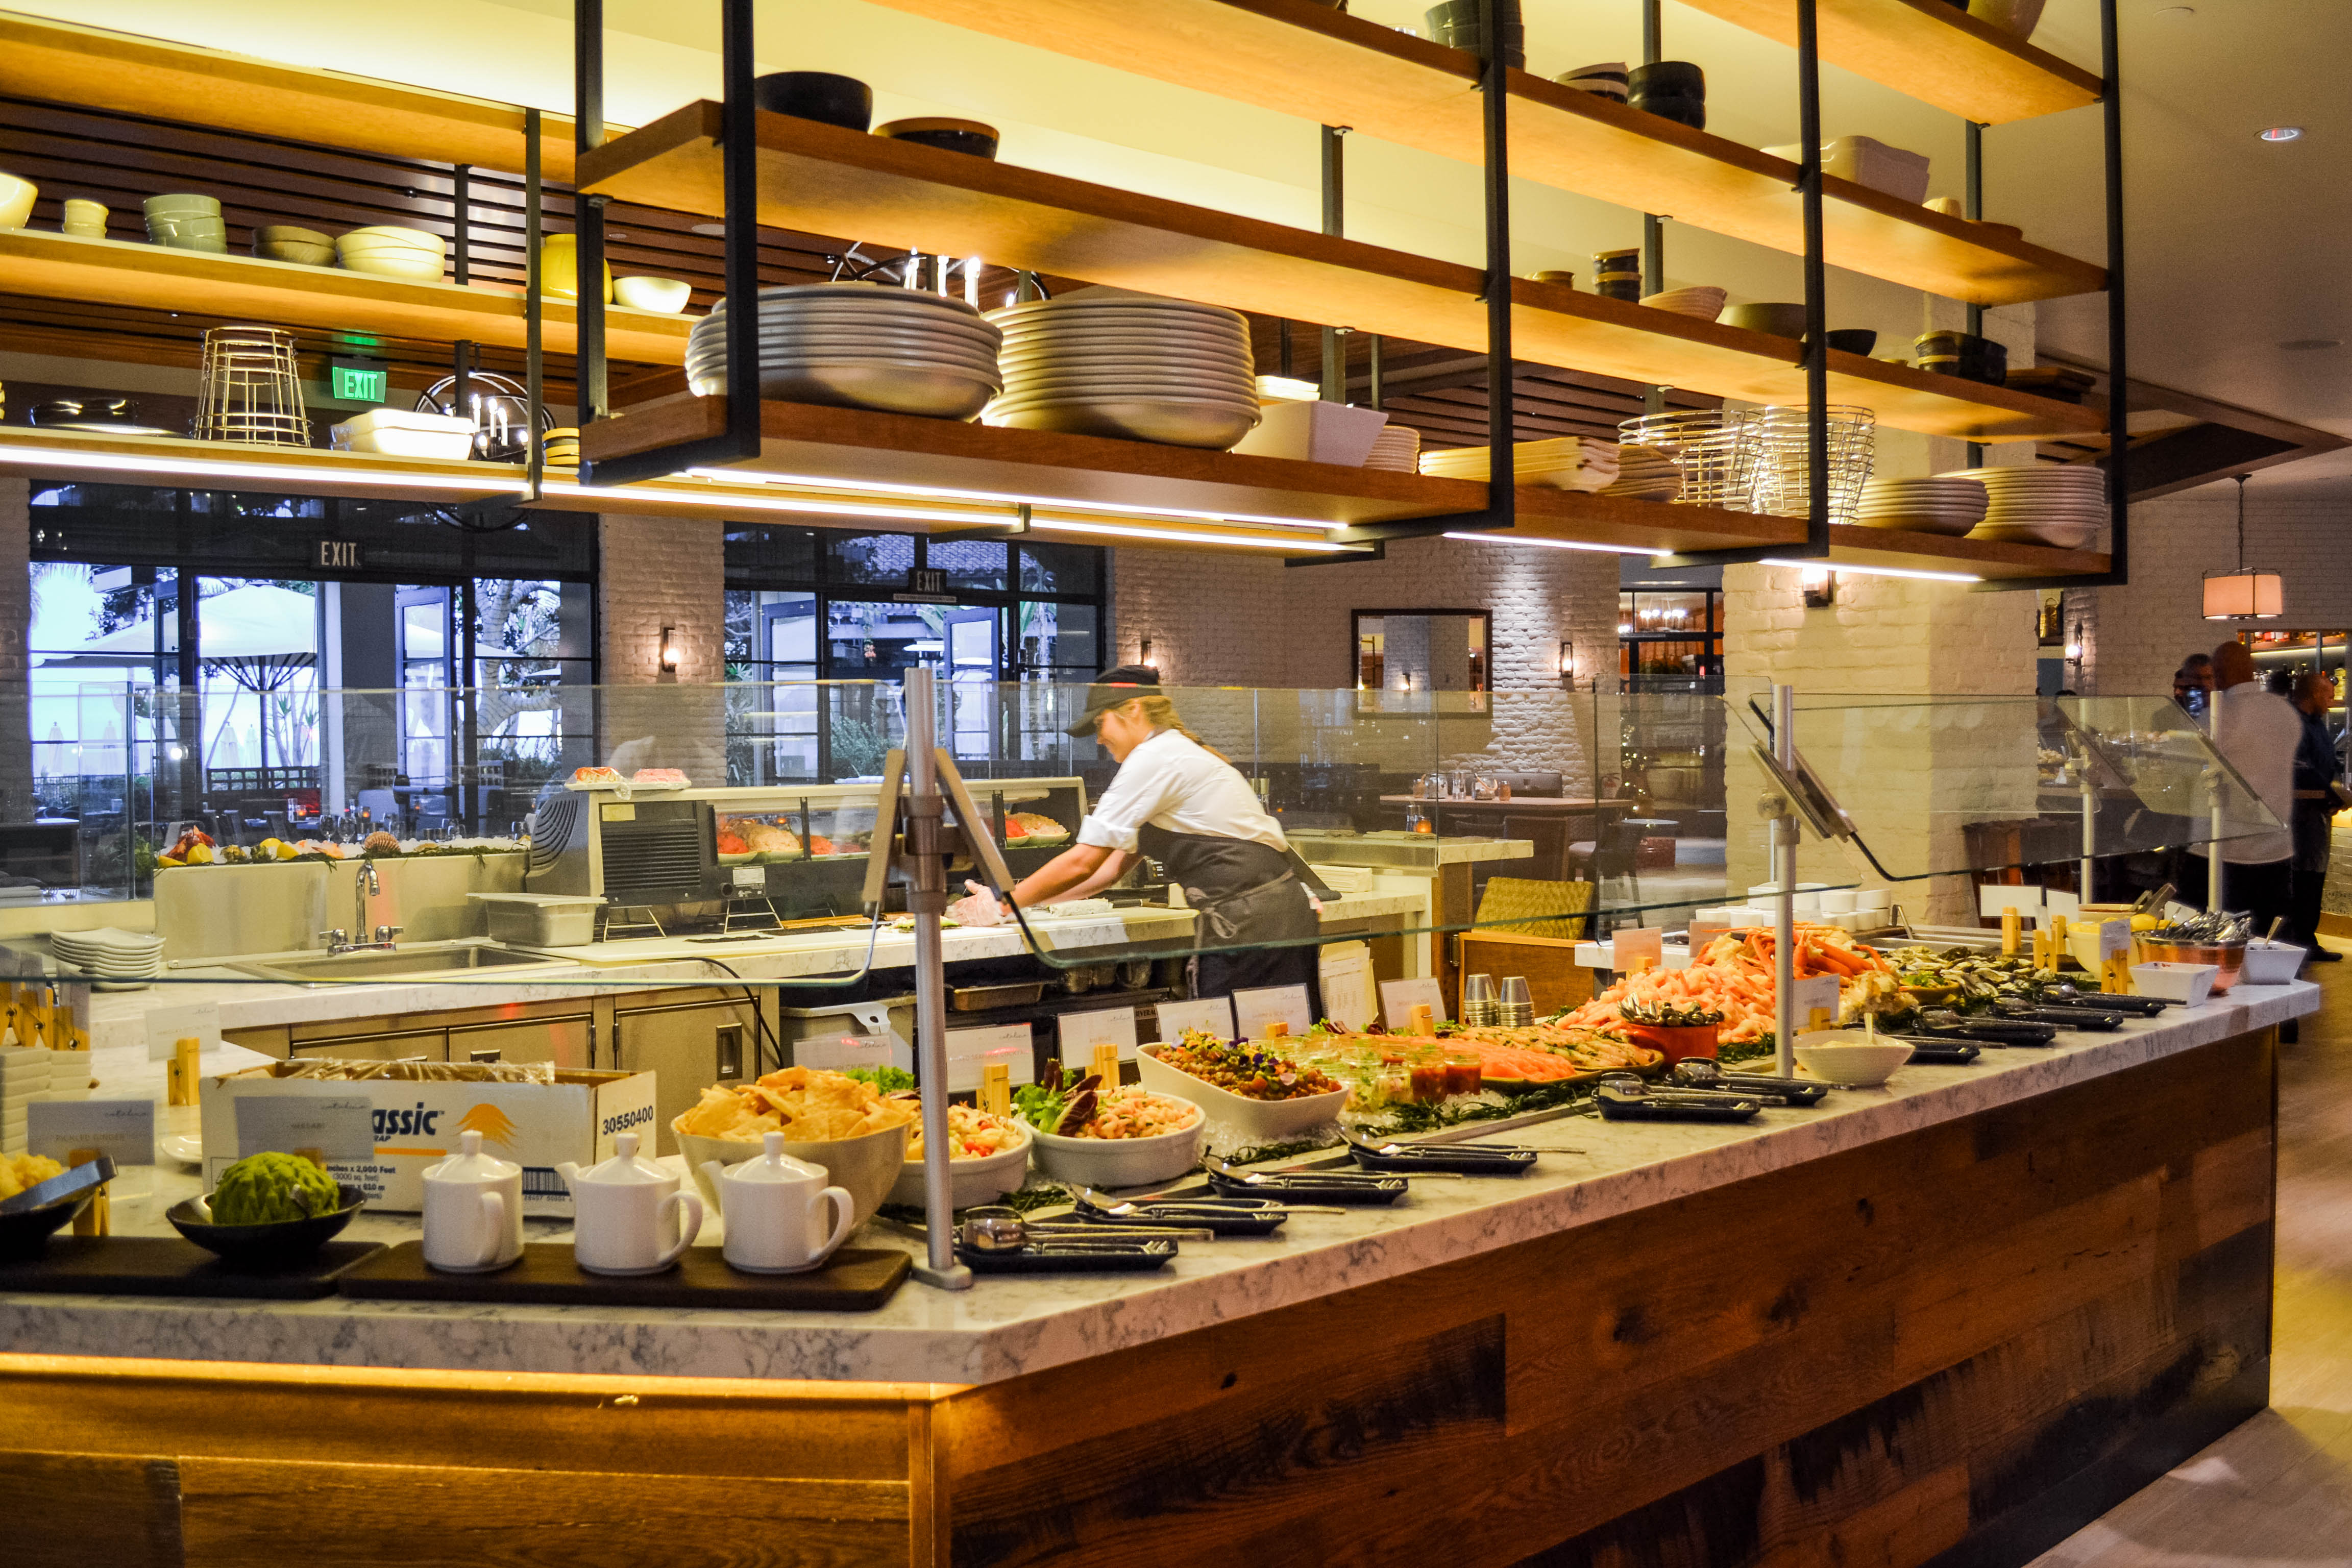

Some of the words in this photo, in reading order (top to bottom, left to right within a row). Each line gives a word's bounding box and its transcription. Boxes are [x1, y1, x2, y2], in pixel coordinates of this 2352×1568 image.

[344, 371, 378, 400] EXIT
[321, 541, 357, 567] EXIT
[917, 571, 941, 592] EXIT
[602, 1105, 654, 1136] 30550400
[93, 1133, 126, 1141] GINGER
